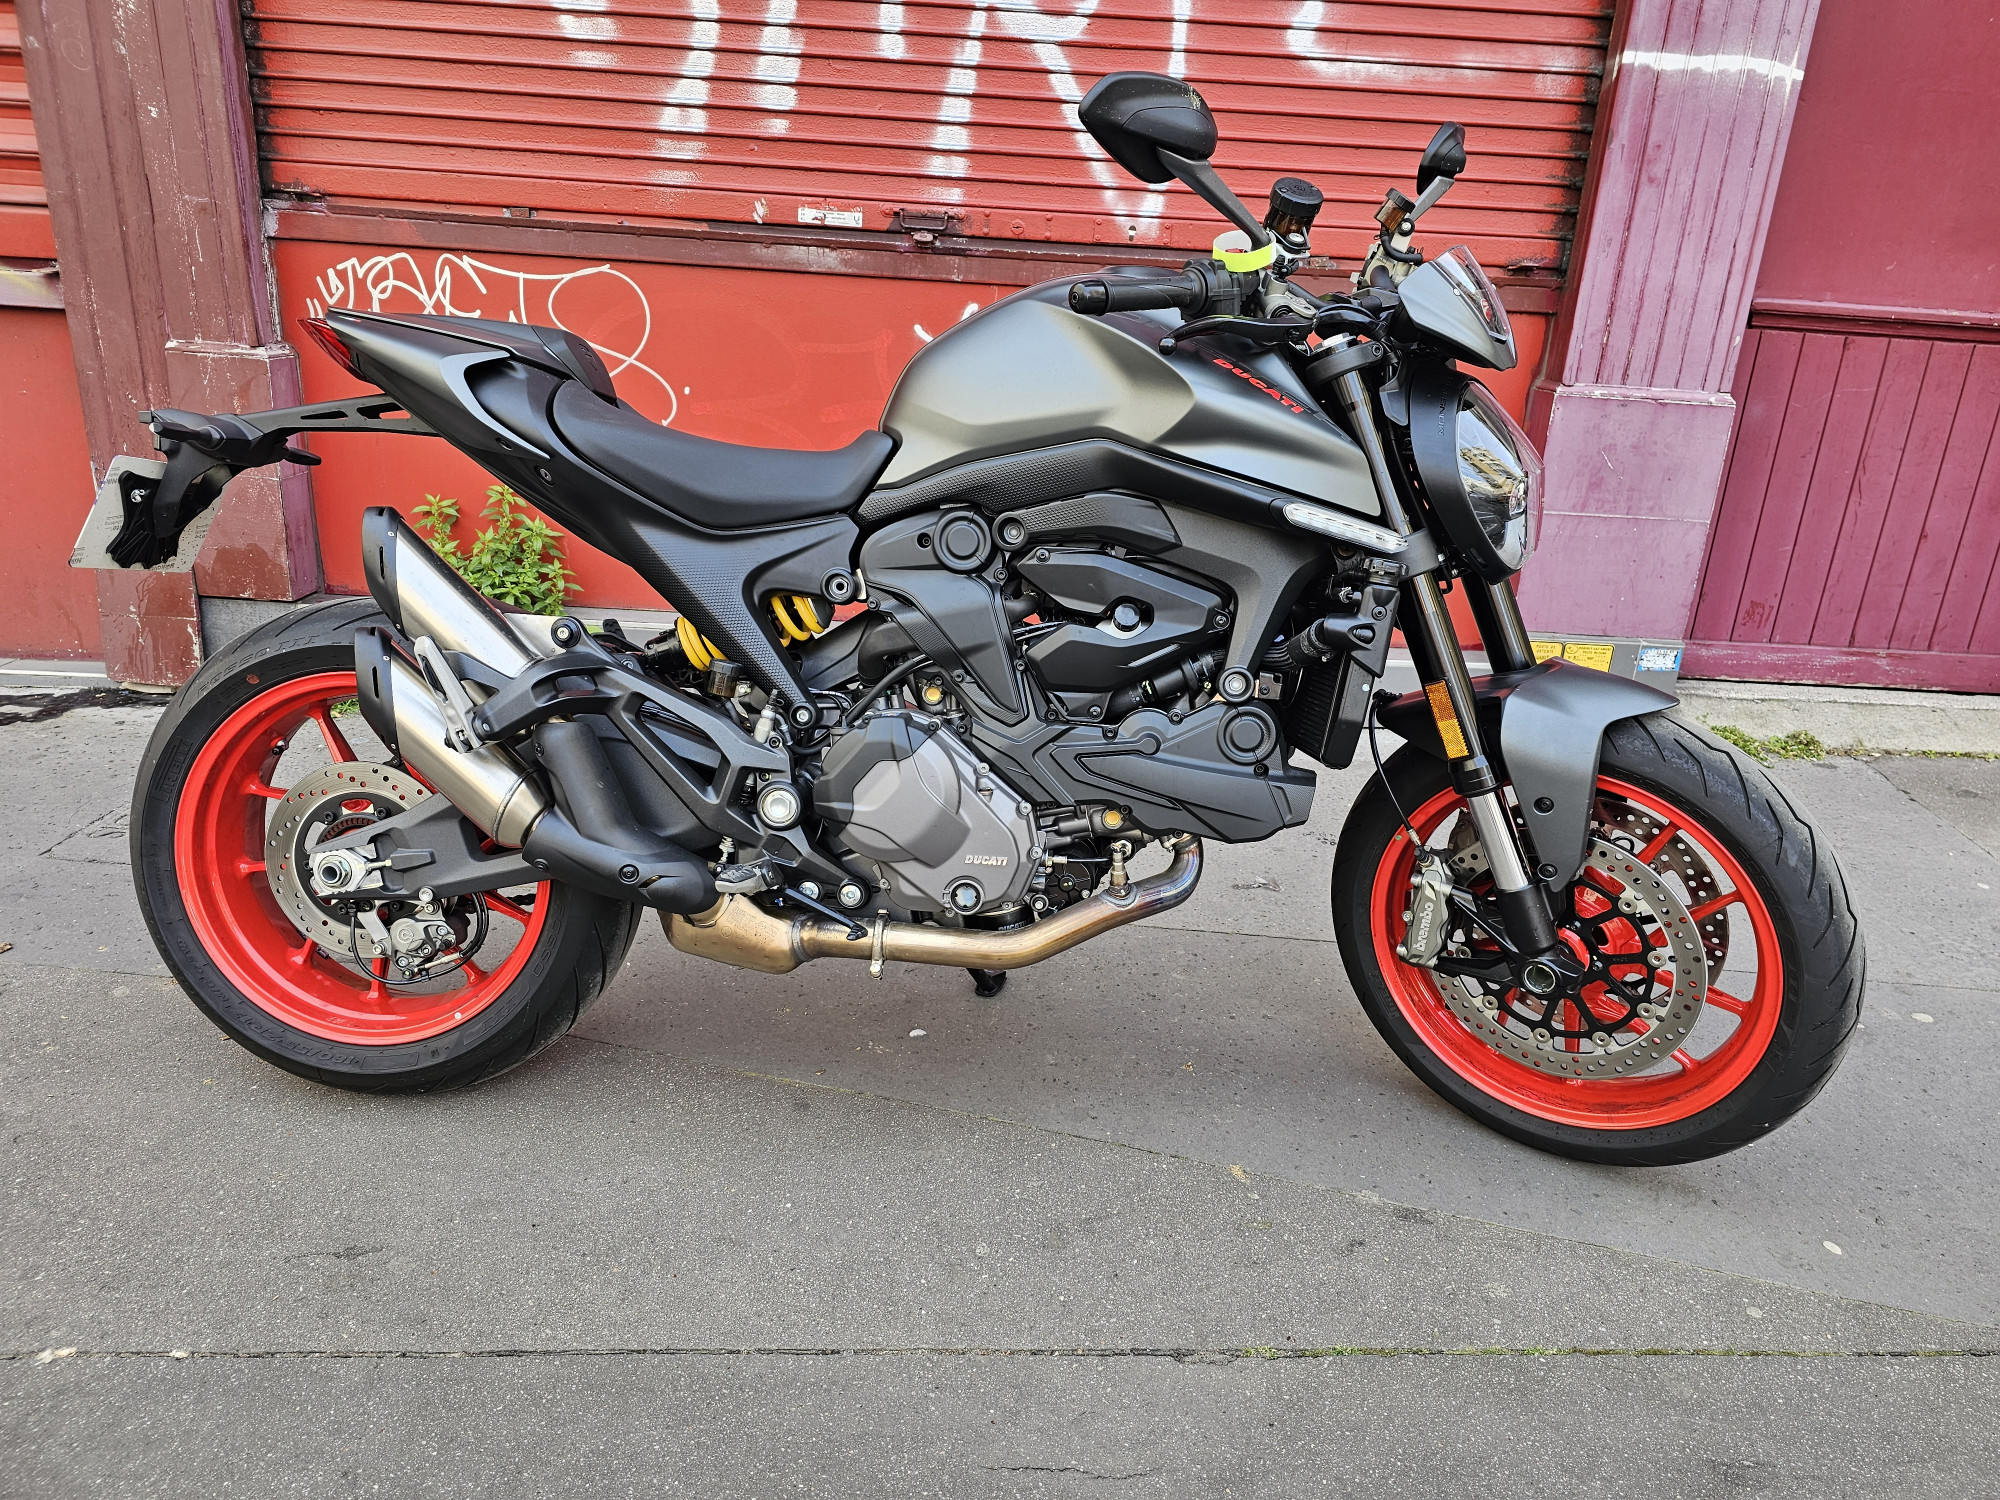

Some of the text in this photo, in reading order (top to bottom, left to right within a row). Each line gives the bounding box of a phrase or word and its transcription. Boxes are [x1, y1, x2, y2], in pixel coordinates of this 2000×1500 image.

[1213, 358, 1304, 413] DUCATI
[964, 854, 1009, 866] DUCATI
[1413, 901, 1435, 952] brembo
